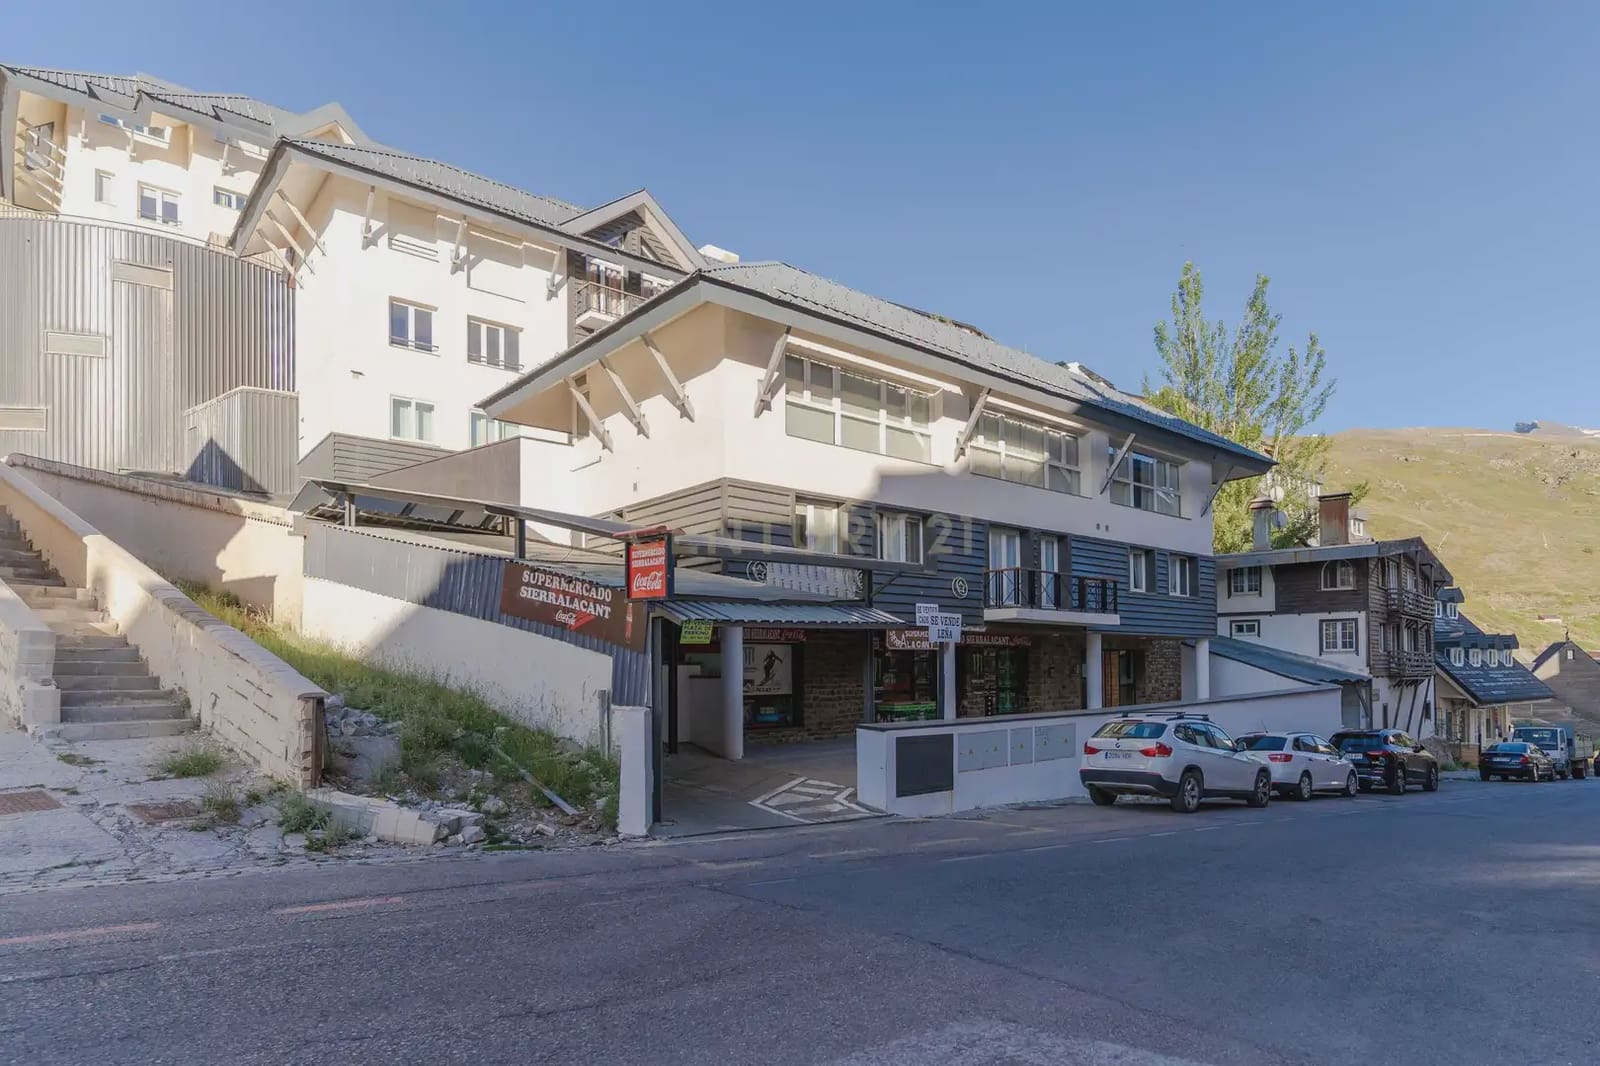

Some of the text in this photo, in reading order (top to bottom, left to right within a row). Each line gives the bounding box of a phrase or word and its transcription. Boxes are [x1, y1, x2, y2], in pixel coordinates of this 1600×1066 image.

[519, 585, 611, 619] SIERRALACANT
[522, 570, 612, 602] SUPERMERCADO
[930, 615, 960, 627] SE VENDE
